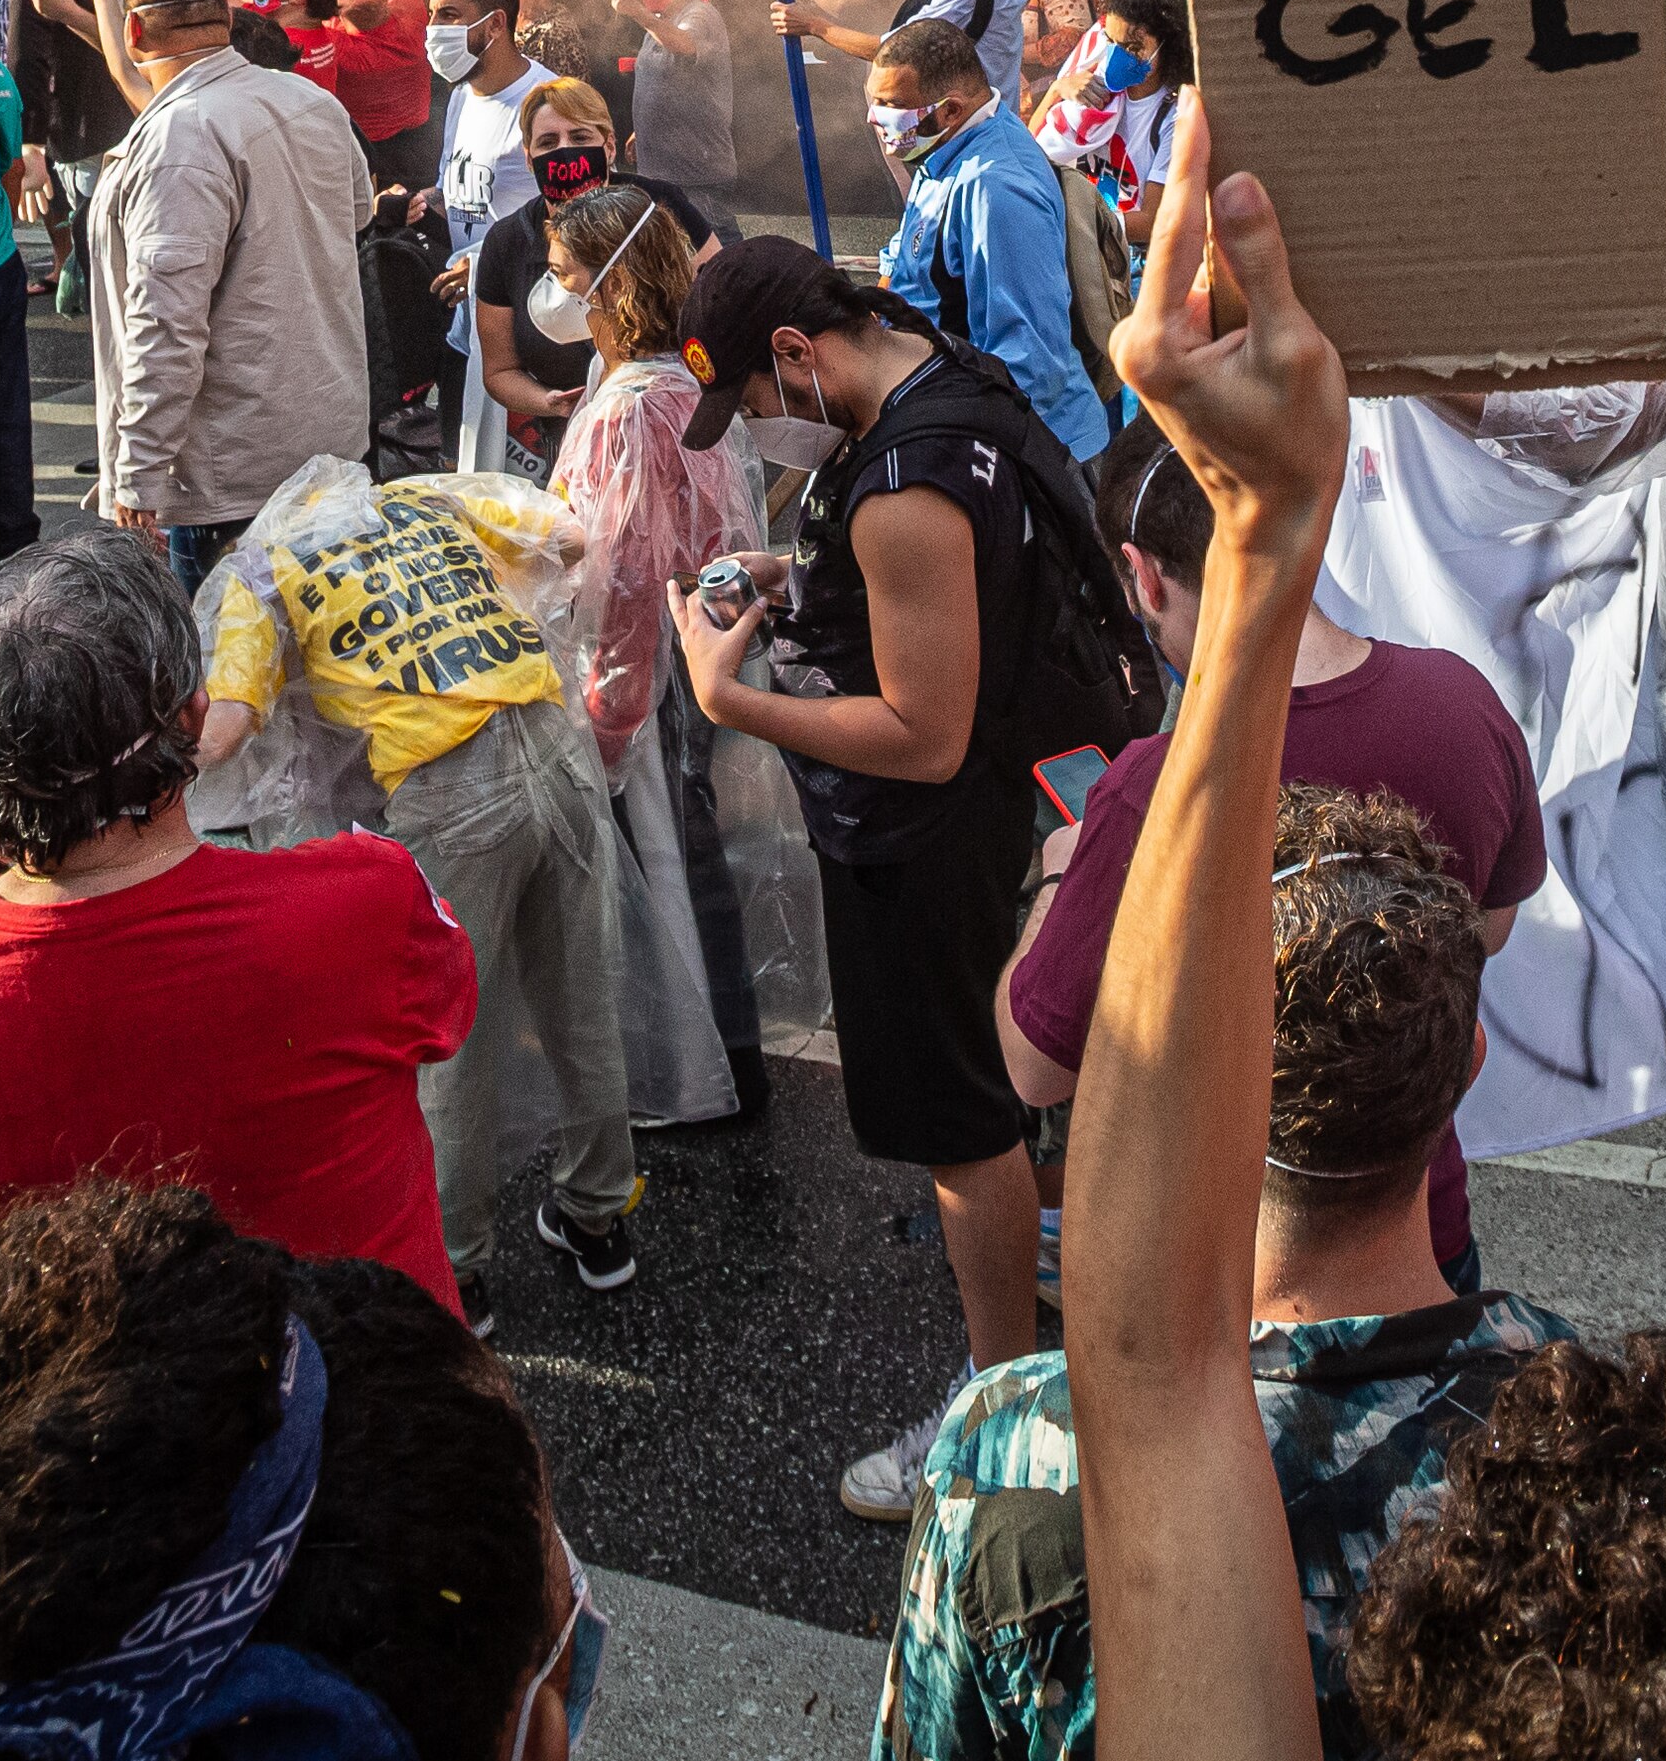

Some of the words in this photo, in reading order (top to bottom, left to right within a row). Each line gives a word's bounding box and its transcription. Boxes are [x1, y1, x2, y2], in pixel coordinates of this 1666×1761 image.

[547, 154, 591, 182] FORA
[299, 581, 325, 614] É
[324, 525, 462, 590] PORQUE
[363, 571, 391, 595] O
[365, 649, 384, 672] É
[385, 614, 451, 656] PIOR
[455, 597, 503, 624] QUE
[375, 619, 546, 693] VÍRUS
